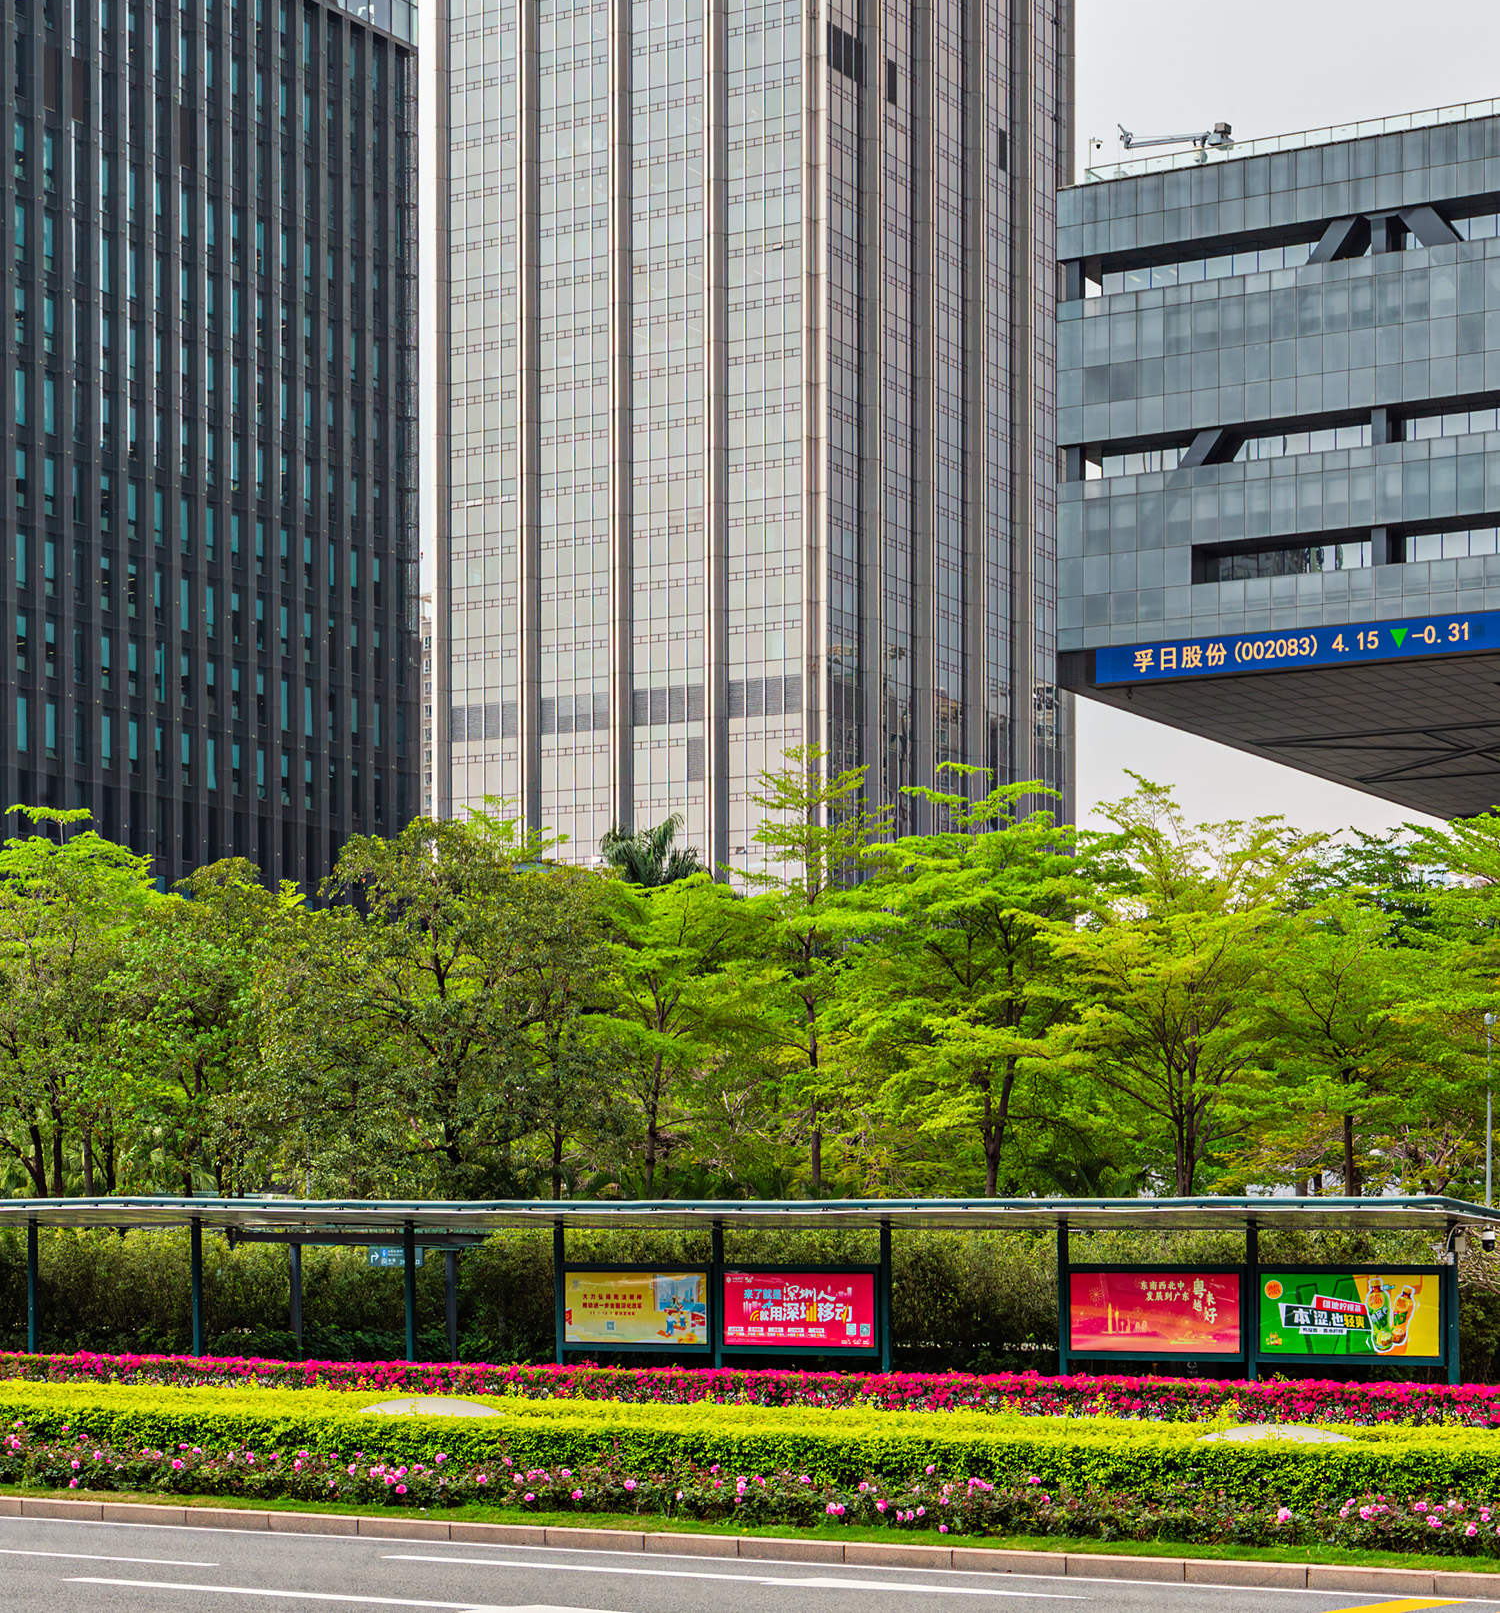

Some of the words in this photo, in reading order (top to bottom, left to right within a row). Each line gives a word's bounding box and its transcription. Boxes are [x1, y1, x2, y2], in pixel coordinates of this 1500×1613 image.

[1133, 642, 1227, 674] 孚日股份
[1234, 634, 1317, 665] (002083)
[1331, 631, 1379, 653] 4.15
[1140, 1280, 1185, 1291] 东南西北中
[1145, 1291, 1190, 1302] 发展到广东
